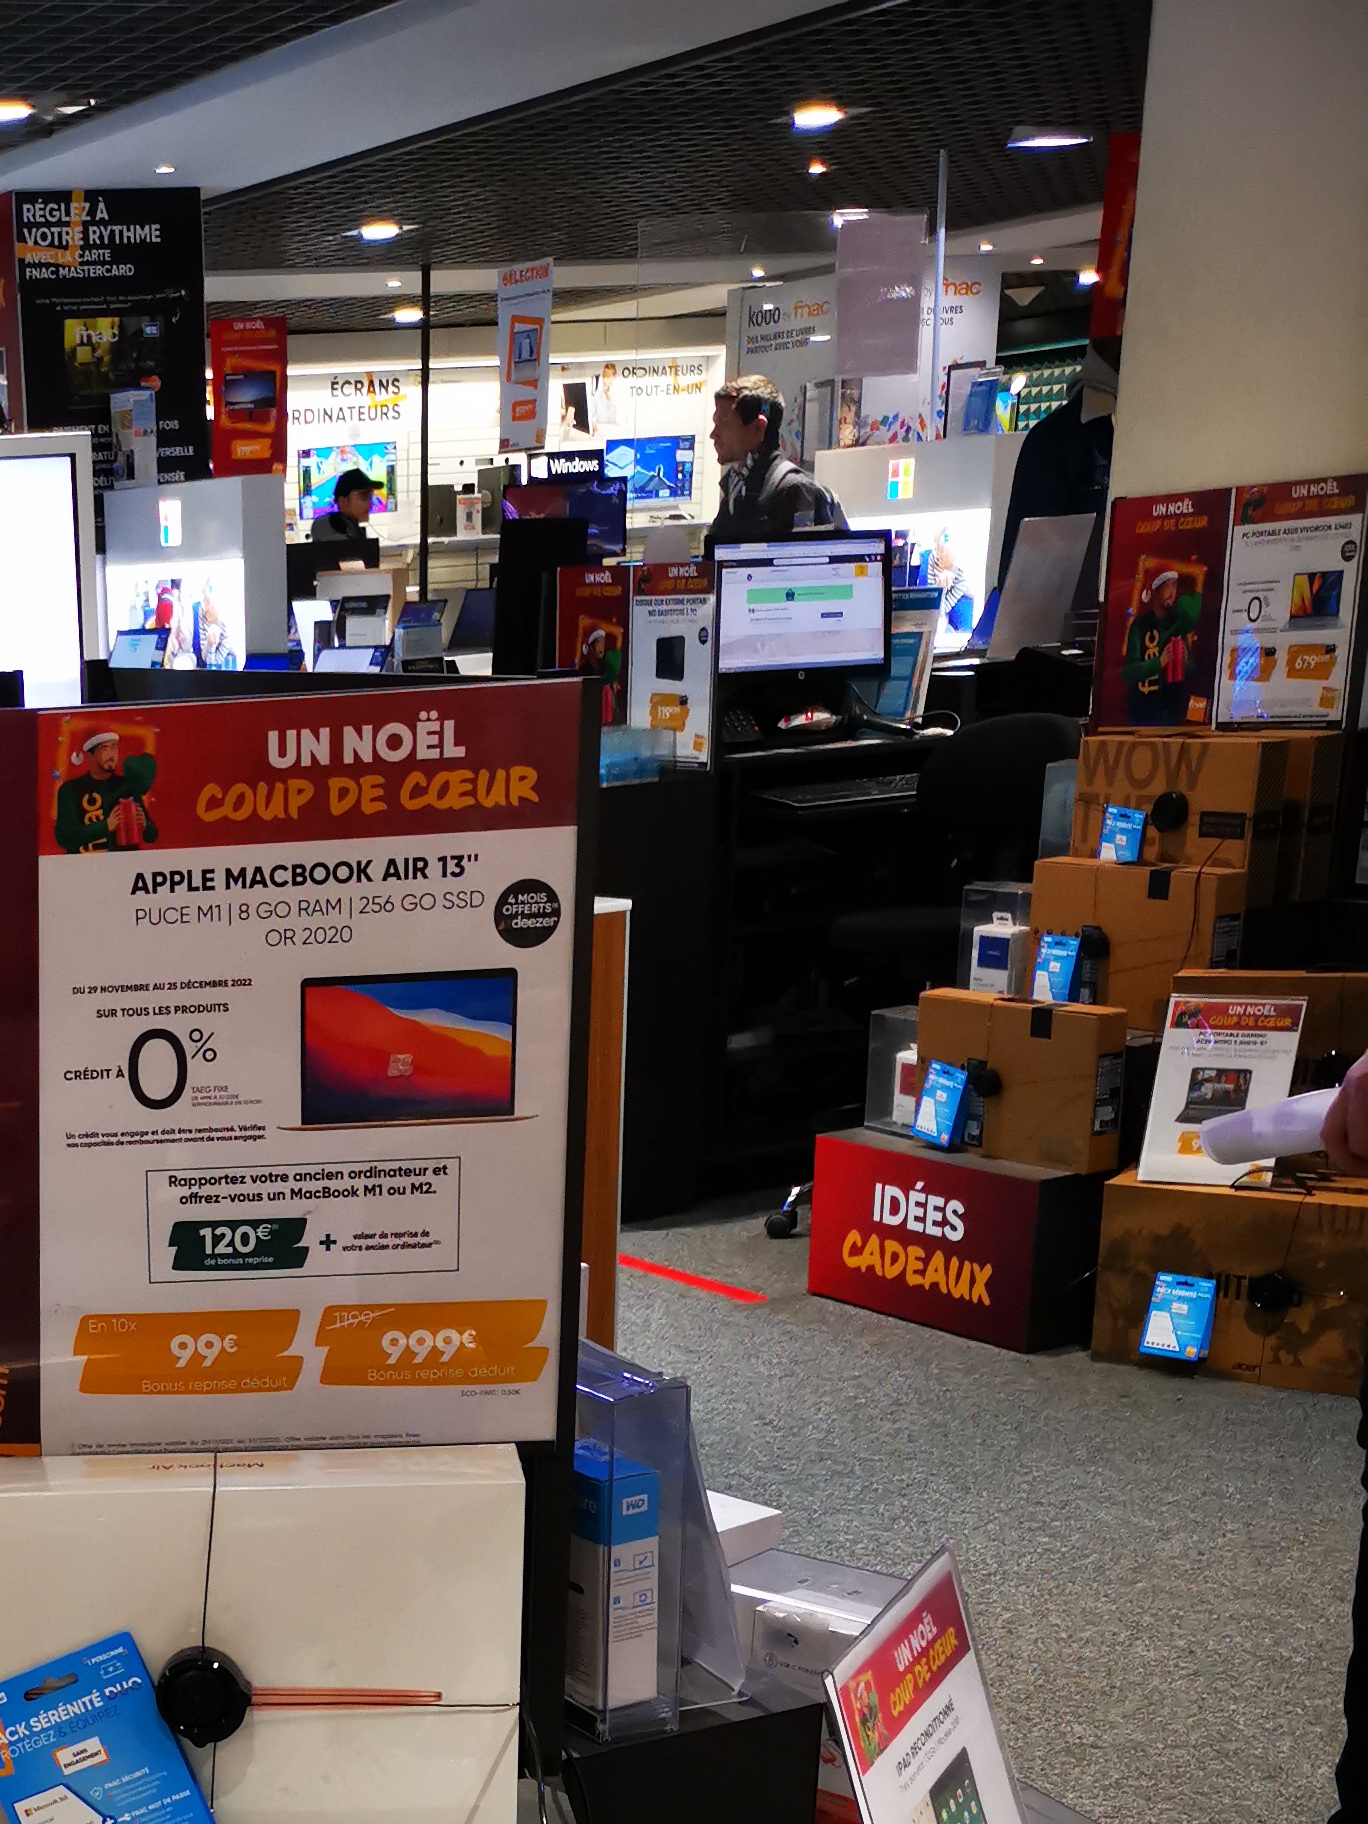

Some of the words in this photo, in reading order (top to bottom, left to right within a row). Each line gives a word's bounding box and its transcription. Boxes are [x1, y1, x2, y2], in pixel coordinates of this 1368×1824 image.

[22, 199, 91, 224] RÉGLEZ
[95, 197, 109, 220] À
[23, 227, 84, 247] VOTRE
[89, 224, 161, 244] RYTHME
[24, 251, 56, 264] AVEC
[59, 251, 72, 262] LA
[74, 250, 111, 262] CARTE
[25, 267, 56, 280] FNAC
[59, 264, 135, 278] MASTERCARD
[792, 300, 830, 322] fnac
[621, 363, 703, 379] ORDINATEURS
[331, 376, 401, 397] ÉCRANS
[630, 382, 702, 397] TOUT-EN-UN
[549, 453, 599, 475] Windows
[267, 728, 330, 770] UN
[343, 711, 465, 763] NOËL
[1079, 740, 1209, 793] WOW
[196, 779, 314, 822] COUP
[328, 774, 387, 816] DE
[400, 765, 539, 810] CŒUR
[130, 868, 215, 896] APPLE
[225, 861, 374, 890] MACBOOK
[382, 856, 429, 881] AIR
[135, 907, 191, 926] PUCE
[196, 903, 221, 923] M1
[238, 903, 250, 921] 8
[256, 901, 291, 920] GO
[299, 899, 343, 917] RAM
[359, 896, 394, 914] 256
[400, 893, 435, 912] GO
[442, 890, 485, 910] SSD
[265, 928, 297, 947] OR
[302, 925, 353, 945] 2020
[72, 987, 85, 995] DU
[88, 986, 98, 994] 29
[100, 983, 150, 993] NOVEMBRE
[153, 983, 165, 991] AU
[167, 982, 177, 990] 25
[180, 980, 229, 990] DÉCEMBRE
[231, 979, 253, 987] 2022
[96, 1009, 117, 1018] SUR
[120, 1007, 150, 1017] TOUS
[153, 1006, 171, 1016] LES
[174, 1003, 229, 1014] PRODUITS
[64, 1068, 112, 1080] CRÉDIT
[116, 1065, 125, 1078] À
[169, 1173, 246, 1189] Rapportez
[250, 1172, 289, 1184] votre
[293, 1169, 343, 1182] ancien
[348, 1166, 429, 1180] ordinateur
[432, 1165, 448, 1177] et
[179, 1190, 264, 1205] offrez-vous
[268, 1190, 286, 1201] un
[290, 1184, 359, 1200] MacBook
[363, 1184, 383, 1196] M1
[386, 1184, 406, 1195] ou
[410, 1182, 437, 1195] M2.
[872, 1182, 965, 1243] IDÉES
[204, 1257, 216, 1265] de
[218, 1256, 243, 1265] bonus
[245, 1255, 273, 1264] reprise
[842, 1228, 993, 1306] CADEAUX
[89, 1319, 108, 1332] En
[111, 1318, 137, 1333] 10x
[169, 1334, 238, 1368] 99€
[380, 1329, 477, 1364] 999€
[142, 1381, 186, 1393] Bonus
[189, 1378, 237, 1392] reprise
[241, 1375, 288, 1389] déduit
[893, 1640, 913, 1671] UN
[909, 1611, 937, 1657] NOËL
[30, 1690, 103, 1731] SÉRÉNITÉ
[103, 1677, 143, 1700] DUO
